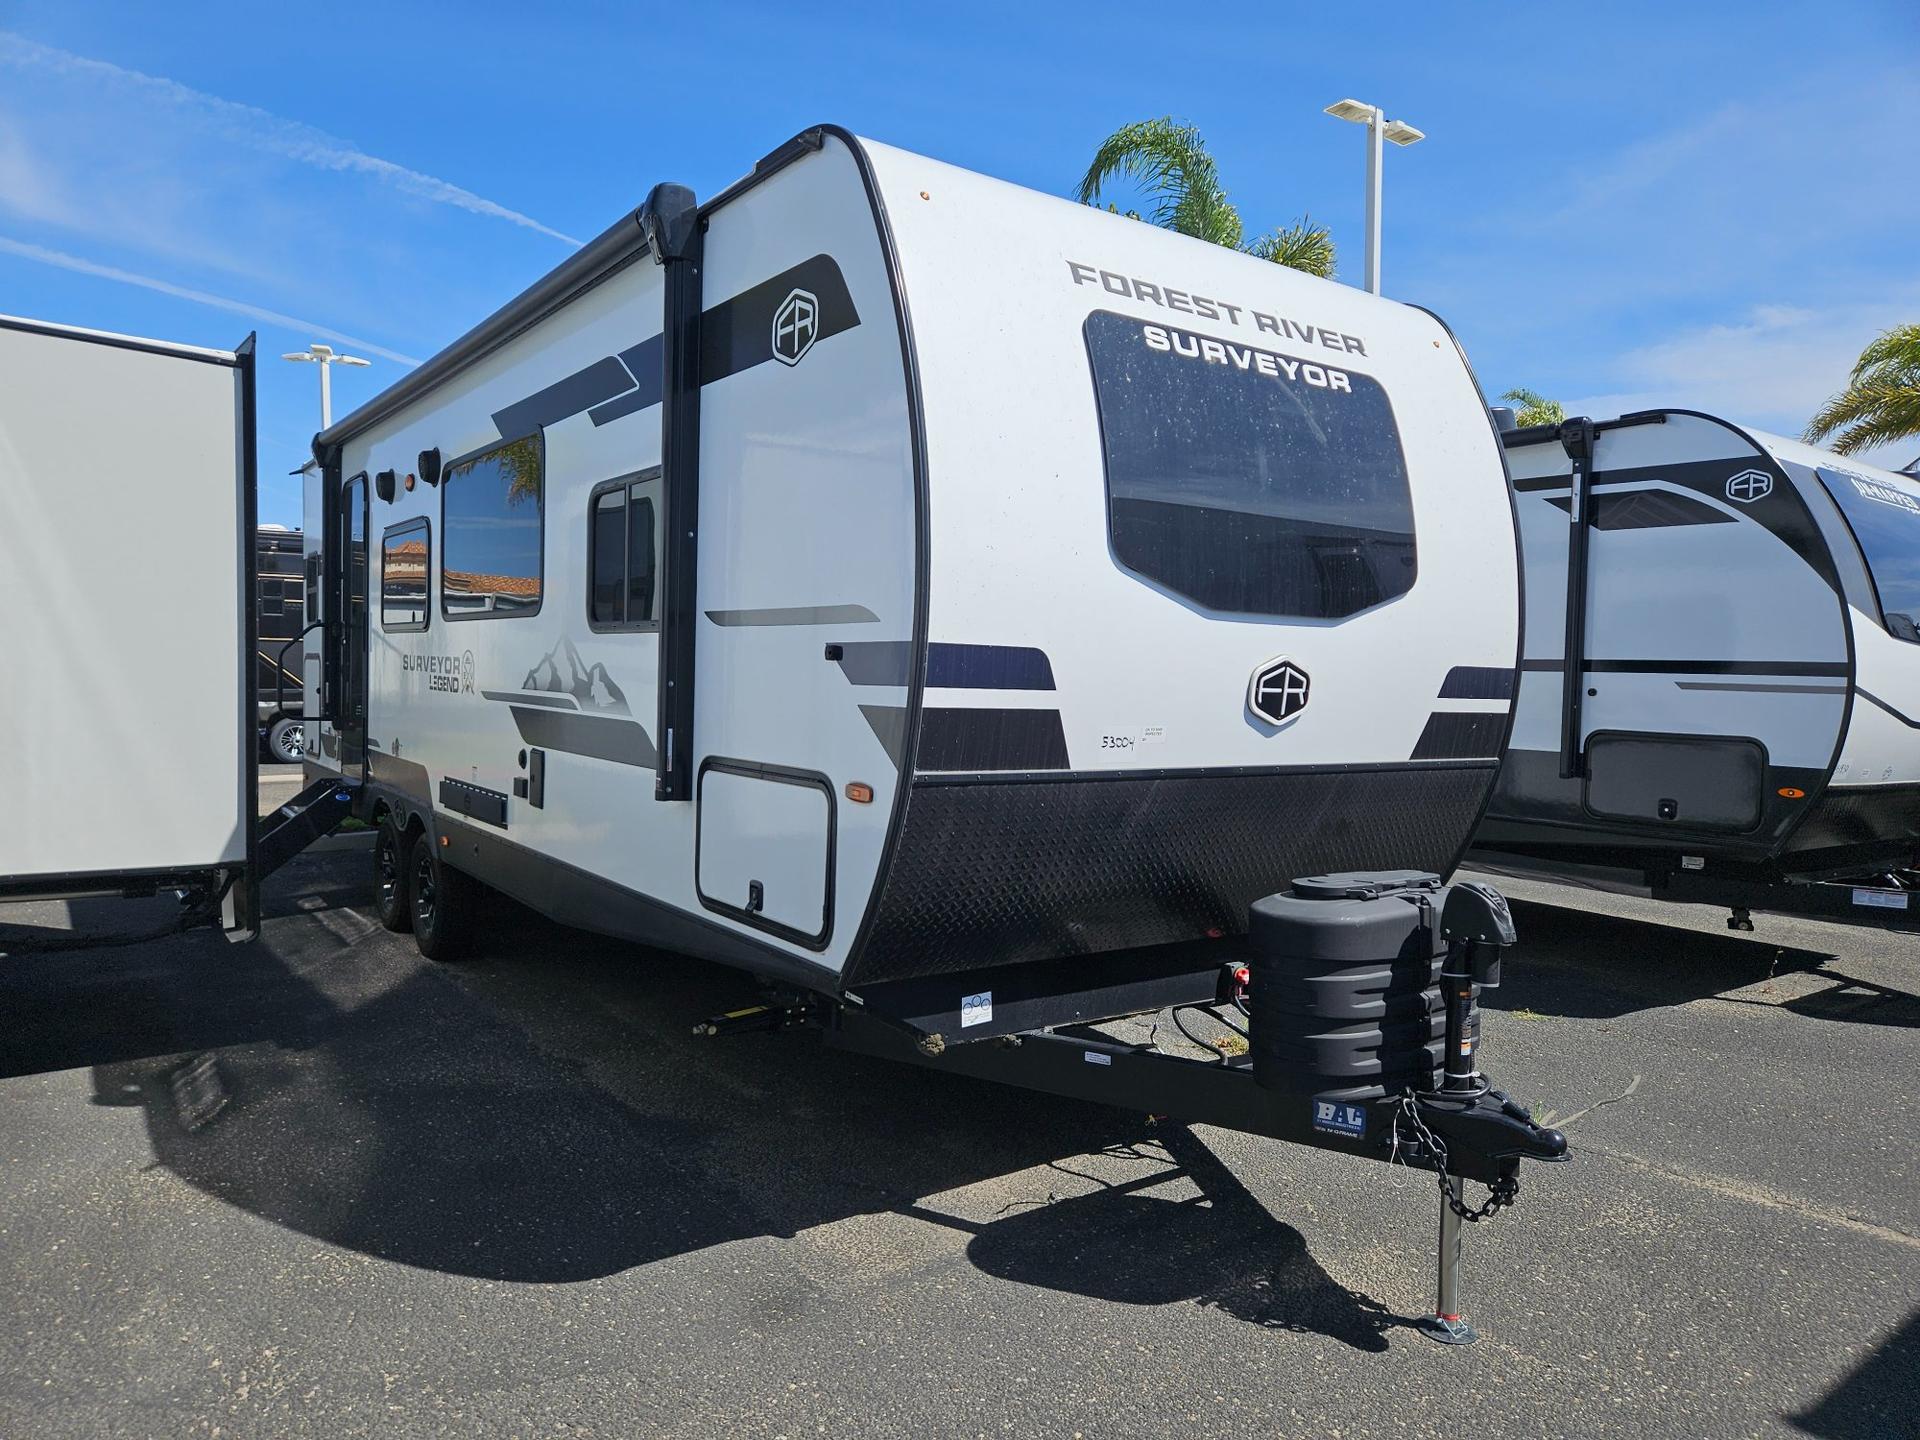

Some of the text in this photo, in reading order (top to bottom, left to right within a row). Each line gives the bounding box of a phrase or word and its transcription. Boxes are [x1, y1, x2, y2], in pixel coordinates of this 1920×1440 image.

[1065, 260, 1368, 358] FOREST RIVER
[1142, 325, 1353, 394] SURVEYOR
[402, 654, 461, 675] SURVEYOR
[429, 674, 460, 693] LEGEND
